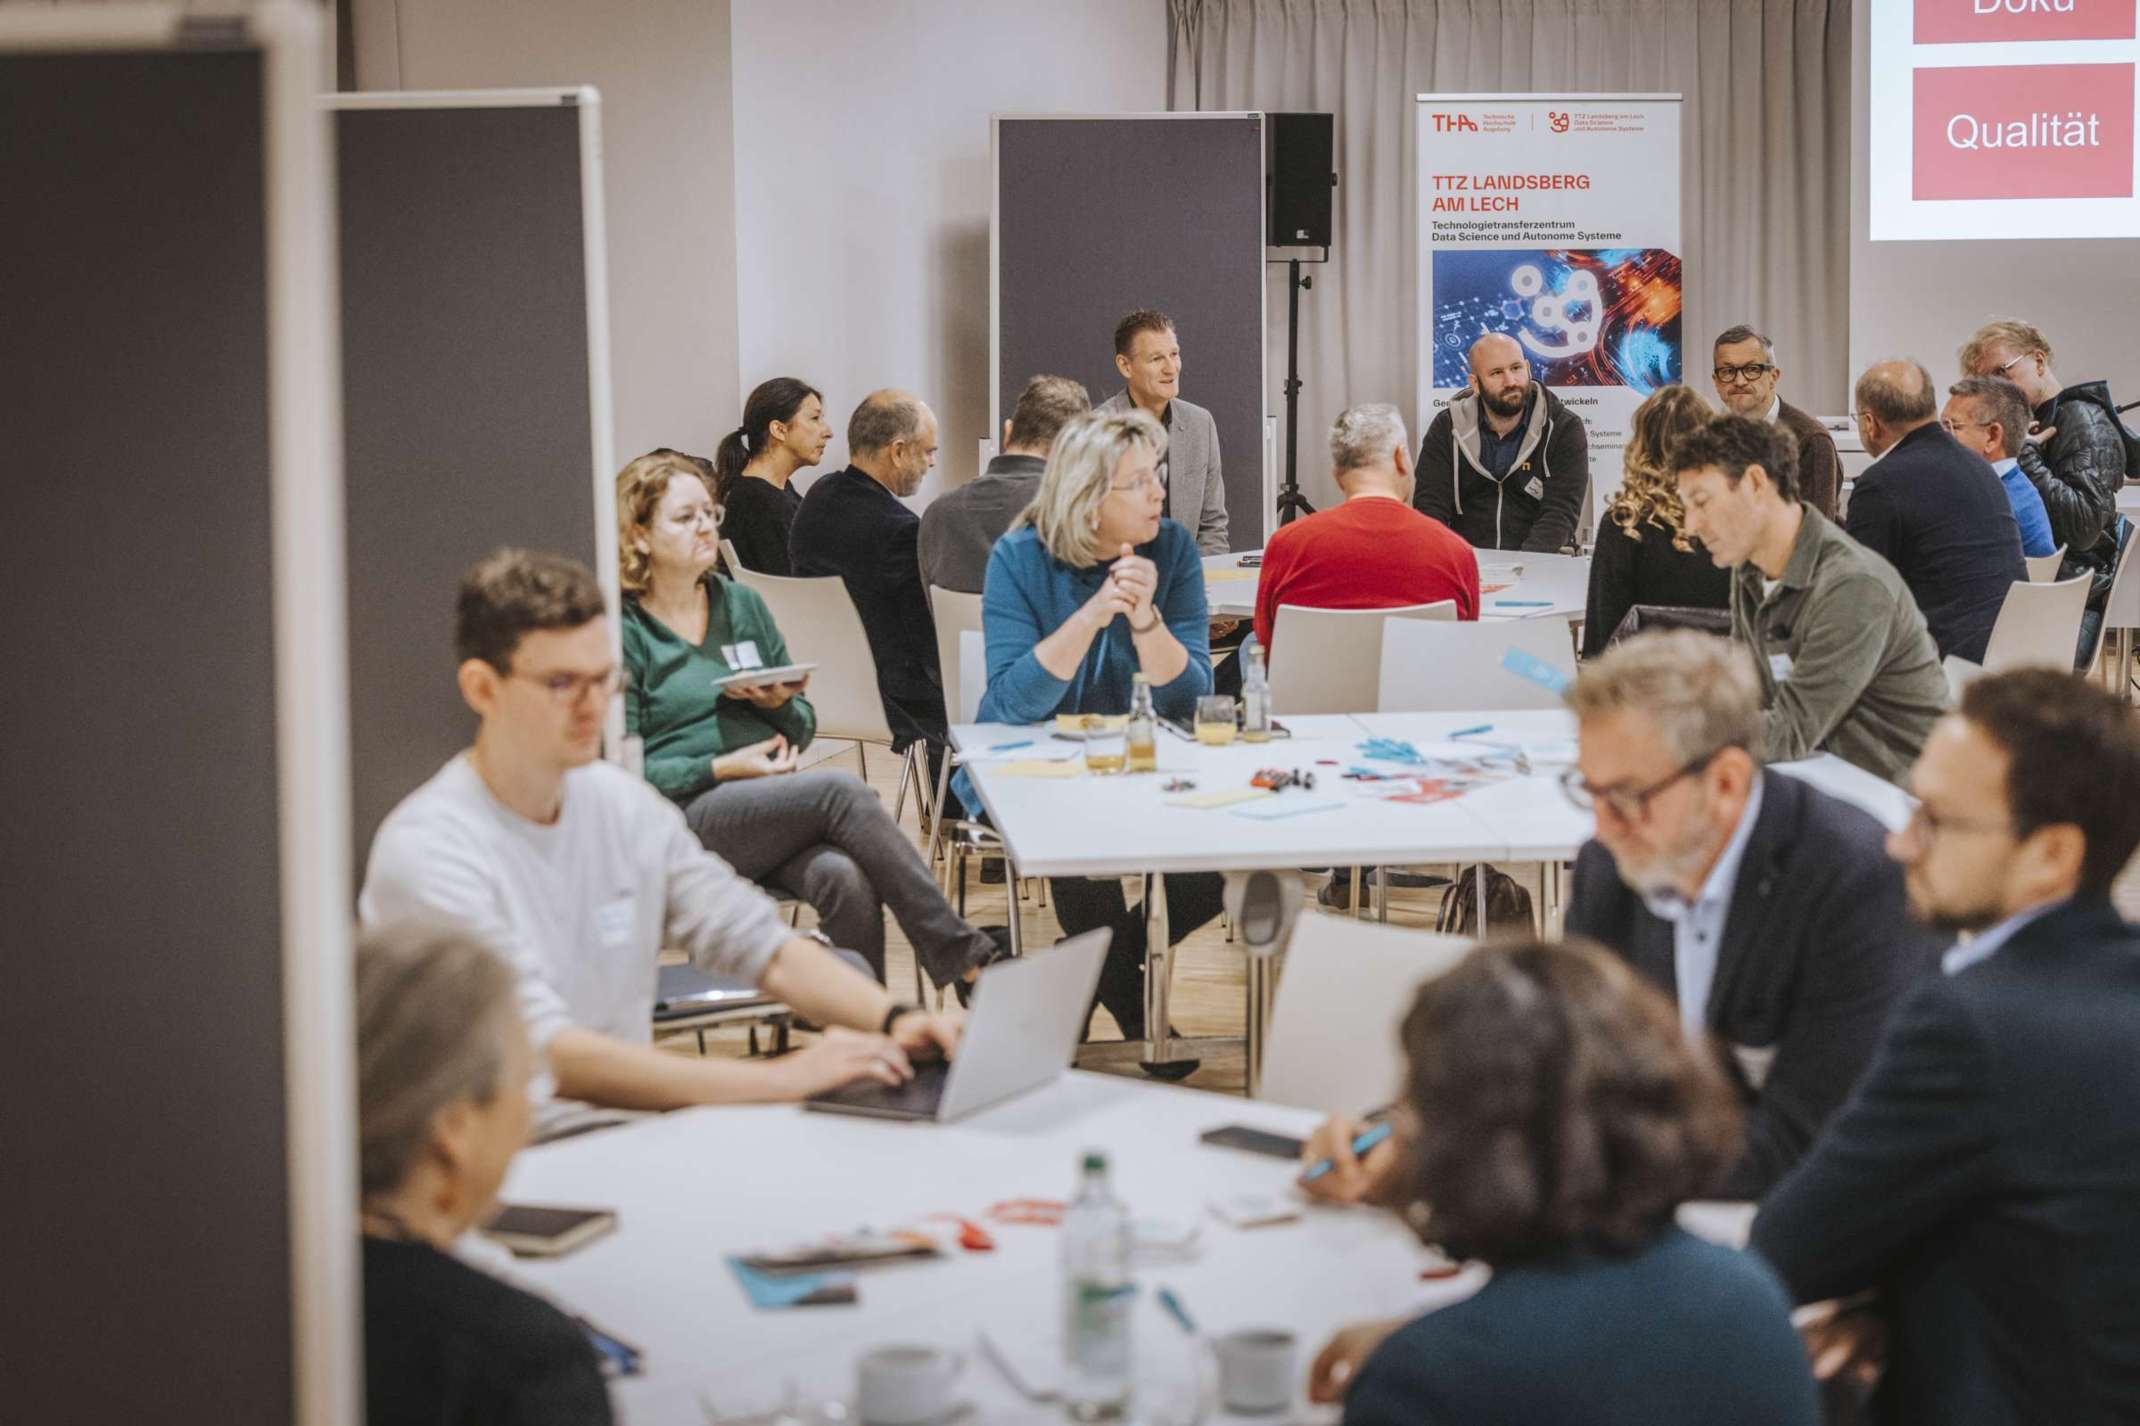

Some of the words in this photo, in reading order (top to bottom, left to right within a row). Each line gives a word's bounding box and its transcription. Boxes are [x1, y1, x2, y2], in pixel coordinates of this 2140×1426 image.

[1947, 113, 2100, 150] Qualität
[1432, 176, 1468, 190] TTZ
[1473, 175, 1590, 190] LANDSBERG
[1432, 197, 1465, 211] AM
[1471, 196, 1519, 211] LECH
[1432, 220, 1575, 232] Technologietransferzentrum
[1432, 232, 1456, 241] Data
[1458, 232, 1499, 241] Science
[1501, 232, 1520, 241] und
[1523, 232, 1575, 241] Autonome
[1577, 231, 1622, 243] Systeme
